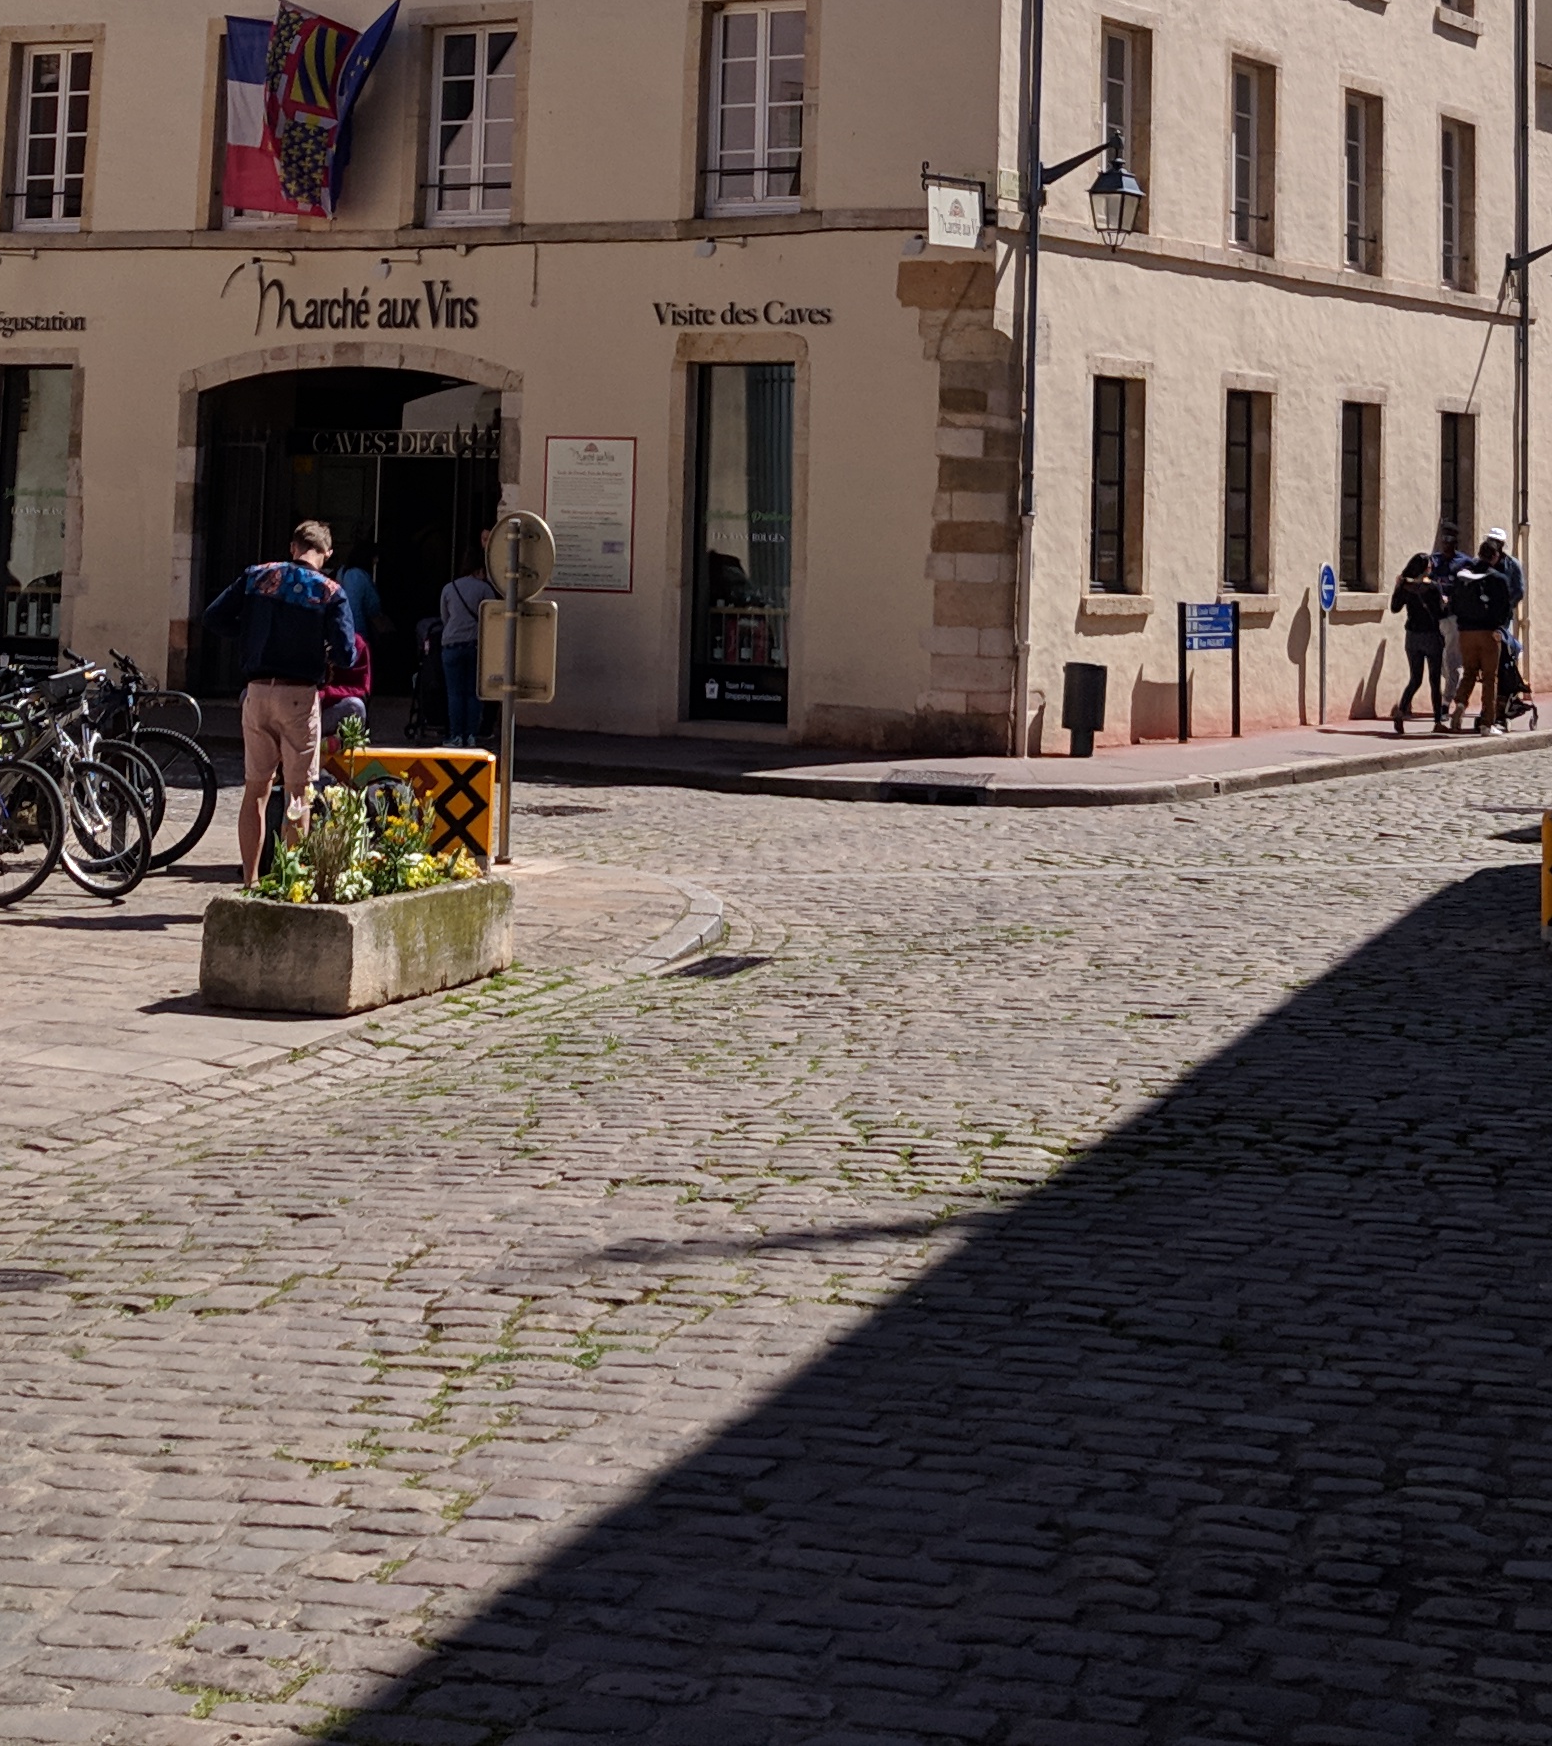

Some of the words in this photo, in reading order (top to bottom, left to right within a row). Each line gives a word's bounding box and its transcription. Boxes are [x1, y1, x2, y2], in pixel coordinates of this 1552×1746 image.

[221, 261, 370, 336] Marché
[377, 297, 421, 330] aux
[422, 280, 479, 330] Vins
[653, 302, 716, 326] Visite
[720, 301, 758, 326] des
[763, 300, 833, 326] Caves
